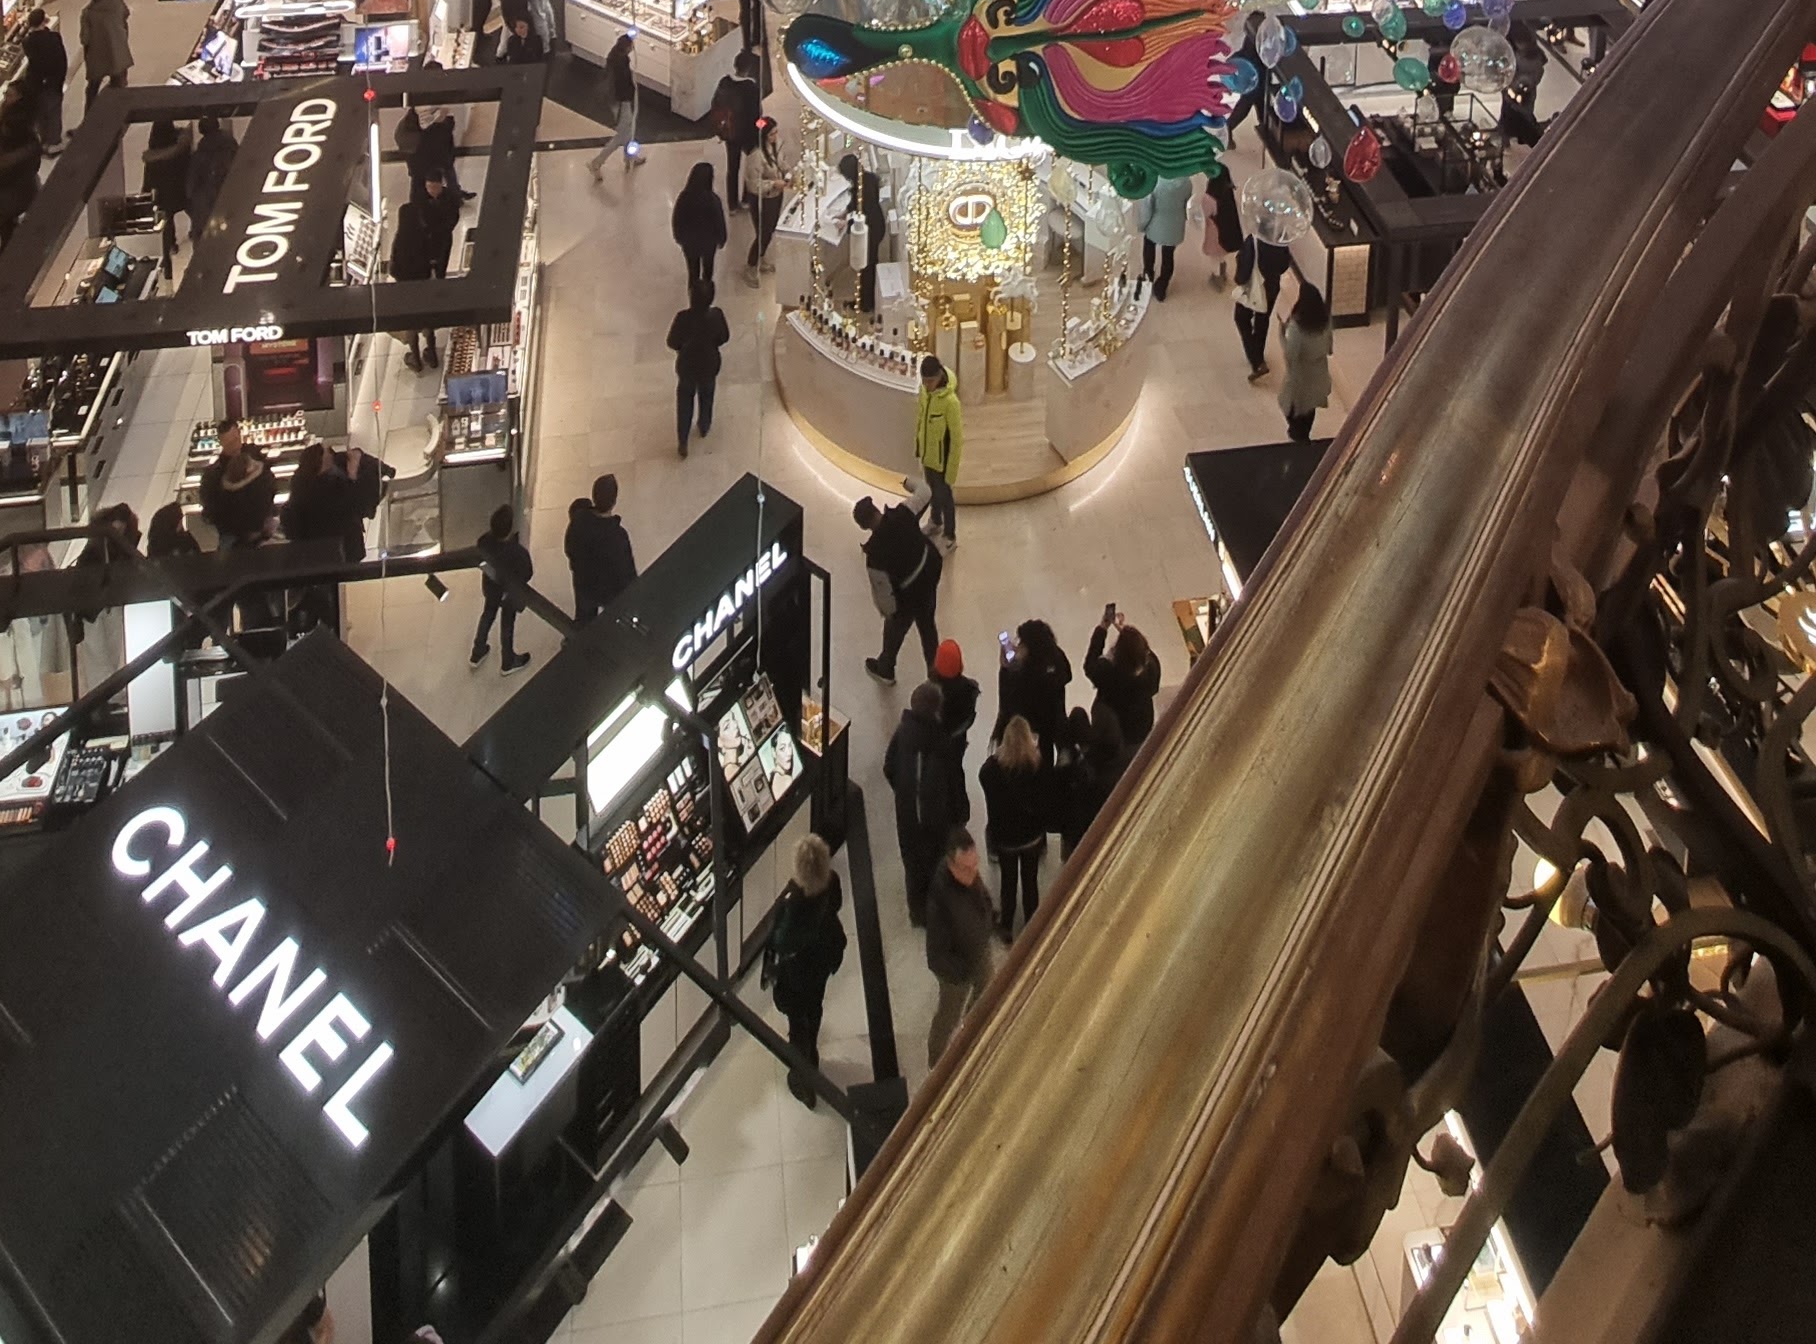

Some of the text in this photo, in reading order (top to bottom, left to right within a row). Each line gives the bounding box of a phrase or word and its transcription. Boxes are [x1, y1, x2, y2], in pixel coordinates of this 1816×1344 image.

[222, 98, 337, 294] TOM FORD
[187, 325, 284, 346] TOM FORD
[672, 541, 788, 670] CHANEL
[112, 806, 395, 1150] CHANEL
